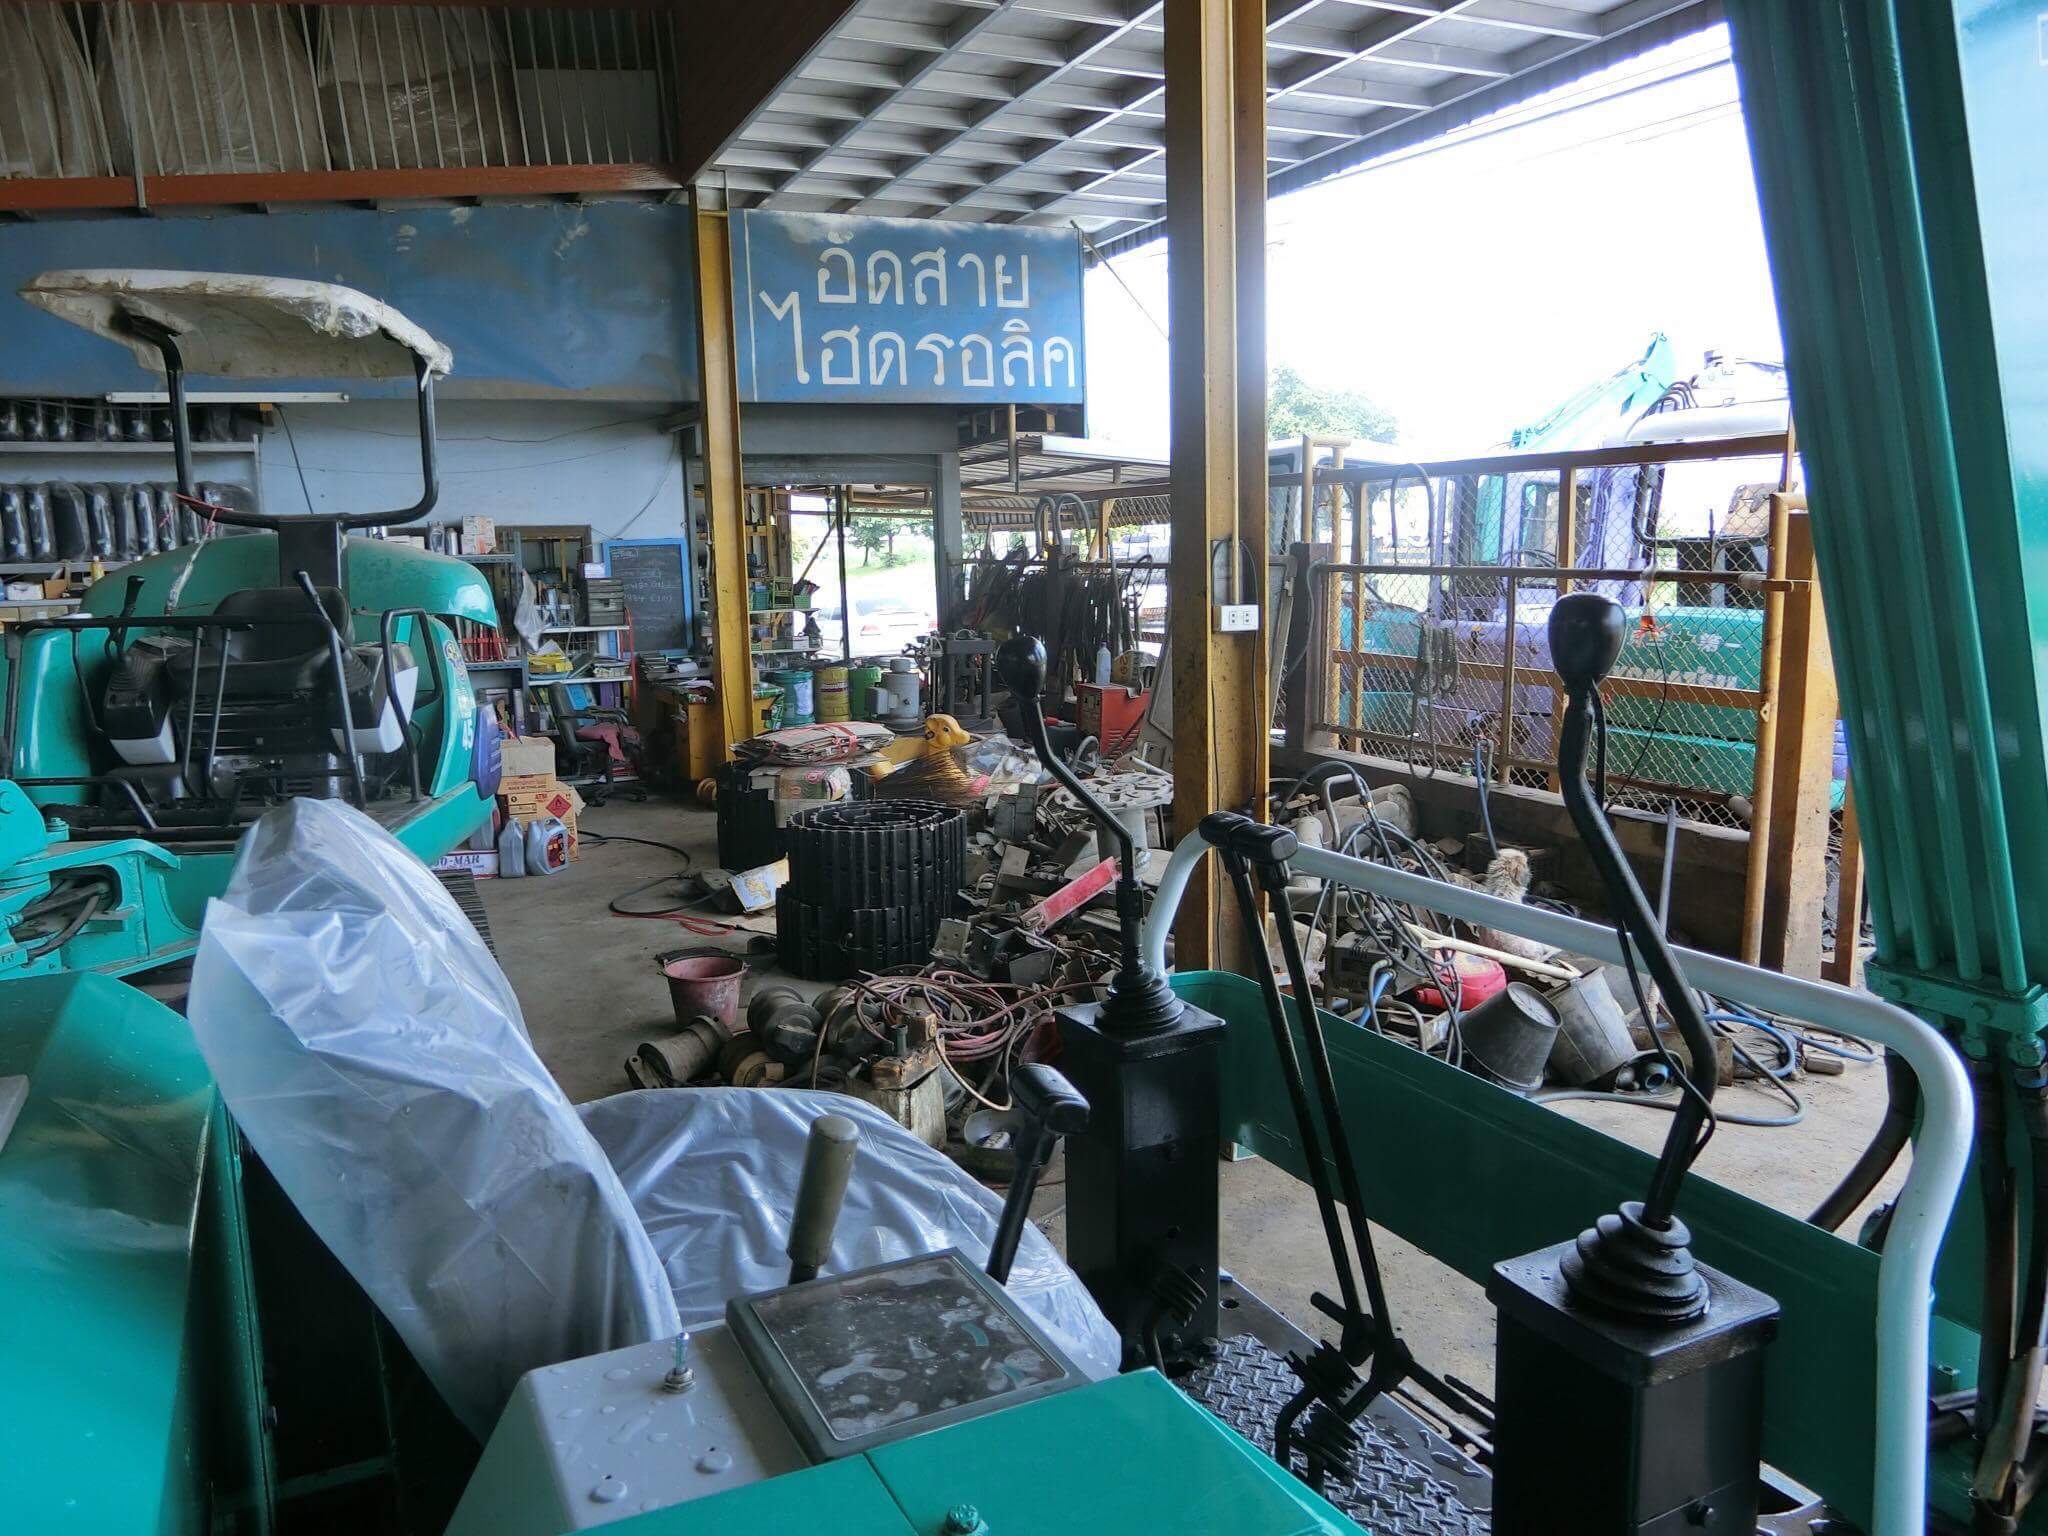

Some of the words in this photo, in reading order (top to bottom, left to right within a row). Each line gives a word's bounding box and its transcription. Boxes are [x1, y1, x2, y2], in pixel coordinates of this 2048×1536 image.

[817, 231, 1031, 309] อัดสาย
[759, 291, 1076, 388] ไฮดรอลิค
